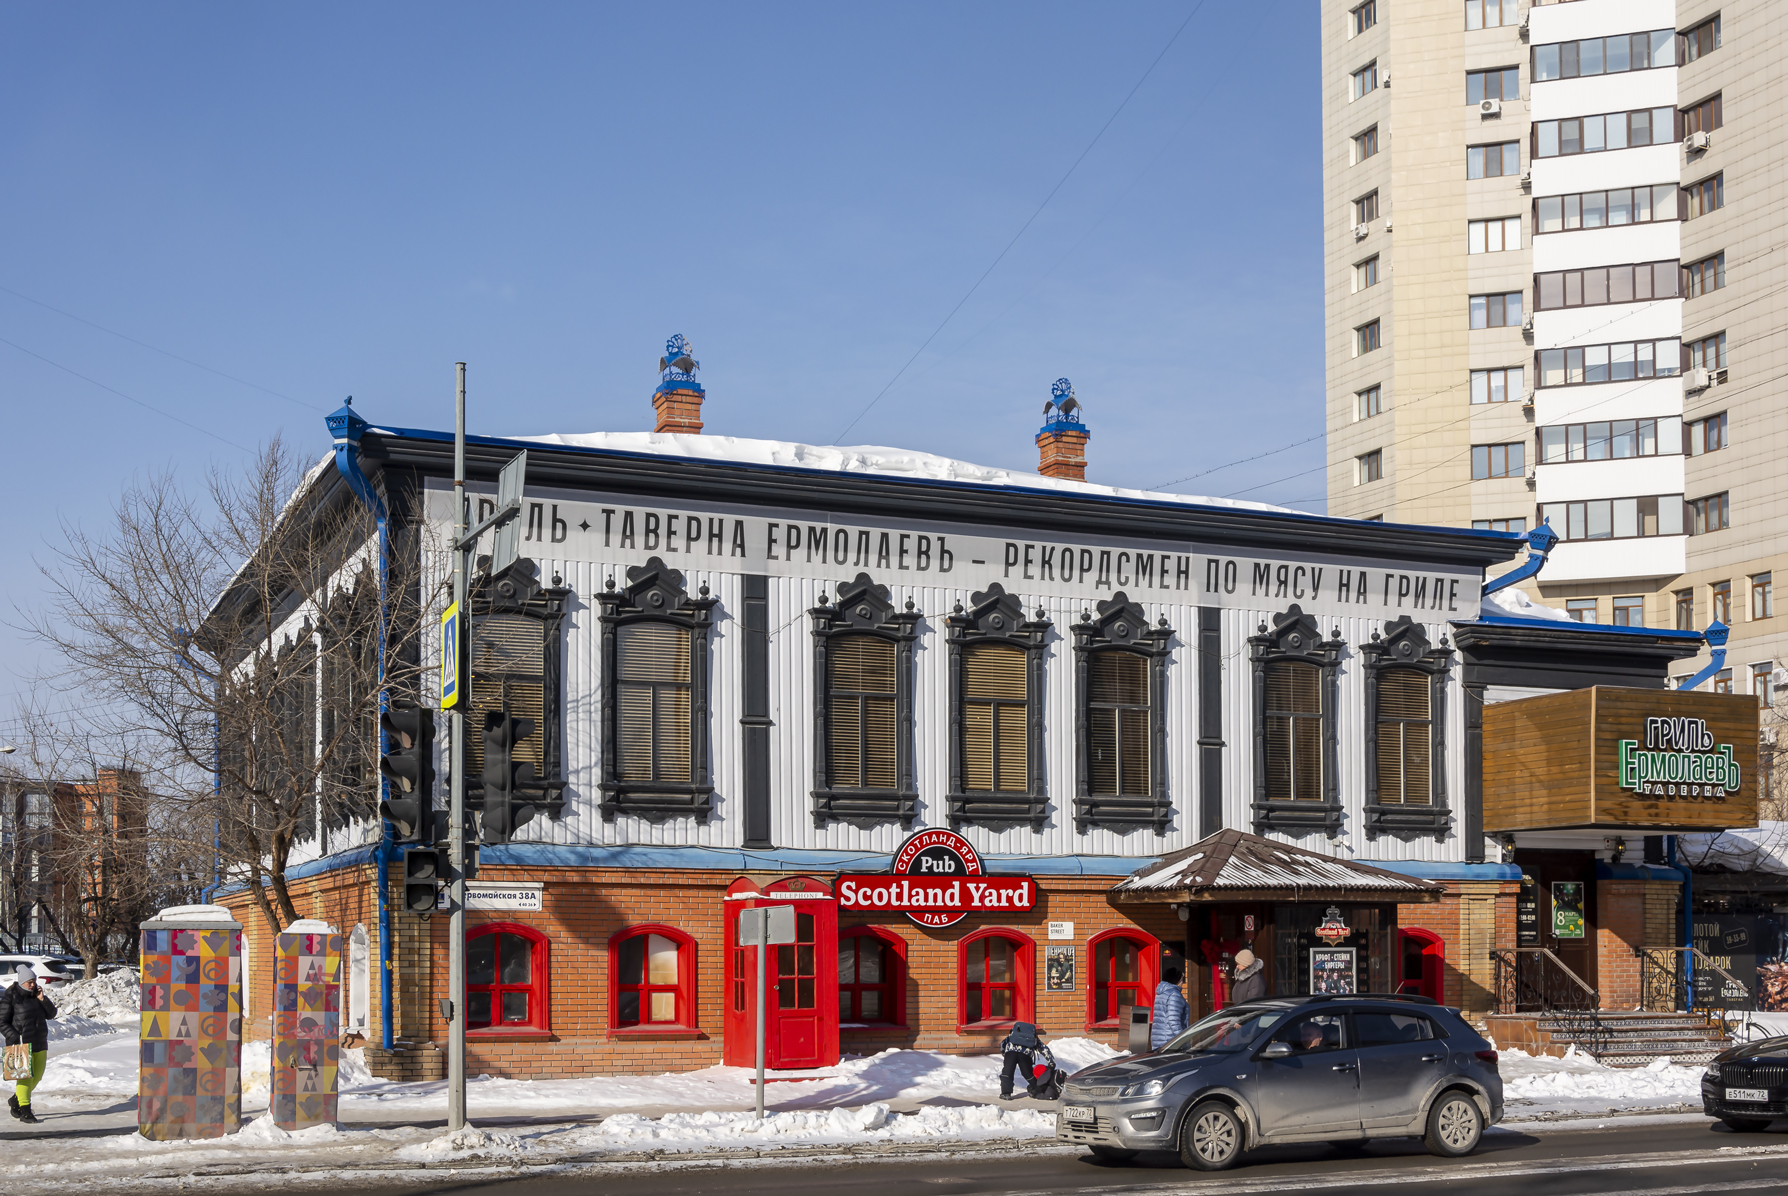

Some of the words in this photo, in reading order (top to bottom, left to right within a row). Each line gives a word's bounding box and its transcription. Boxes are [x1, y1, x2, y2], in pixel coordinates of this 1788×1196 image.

[464, 497, 567, 543] РЛЬ
[601, 508, 747, 558] ТАВЕРНА
[767, 522, 954, 573] ЕРМОЛАЕВЪ
[1004, 542, 1191, 591] РЕКОРДСМЕН
[1206, 558, 1238, 594] ПО
[1251, 562, 1323, 600] МЯСУ
[1337, 569, 1368, 604] НА
[1383, 573, 1460, 612] ГРИЛЕ
[1644, 784, 1725, 797] ТАВЕРНА
[898, 833, 977, 871] СКОТЛАНД-ЯРД
[920, 855, 956, 872] Pub
[465, 891, 517, 901] рвомайская
[518, 892, 537, 900] 38А
[840, 880, 961, 906] Scotland
[967, 881, 1030, 907] Yard
[923, 913, 949, 924] ПАБ
[1556, 911, 1565, 926] 8
[1693, 922, 1720, 937] ЛОТОЙ
[1693, 937, 1709, 953] ЕЙК
[1757, 1090, 1765, 1098] 72
[1086, 1108, 1092, 1116] 72
